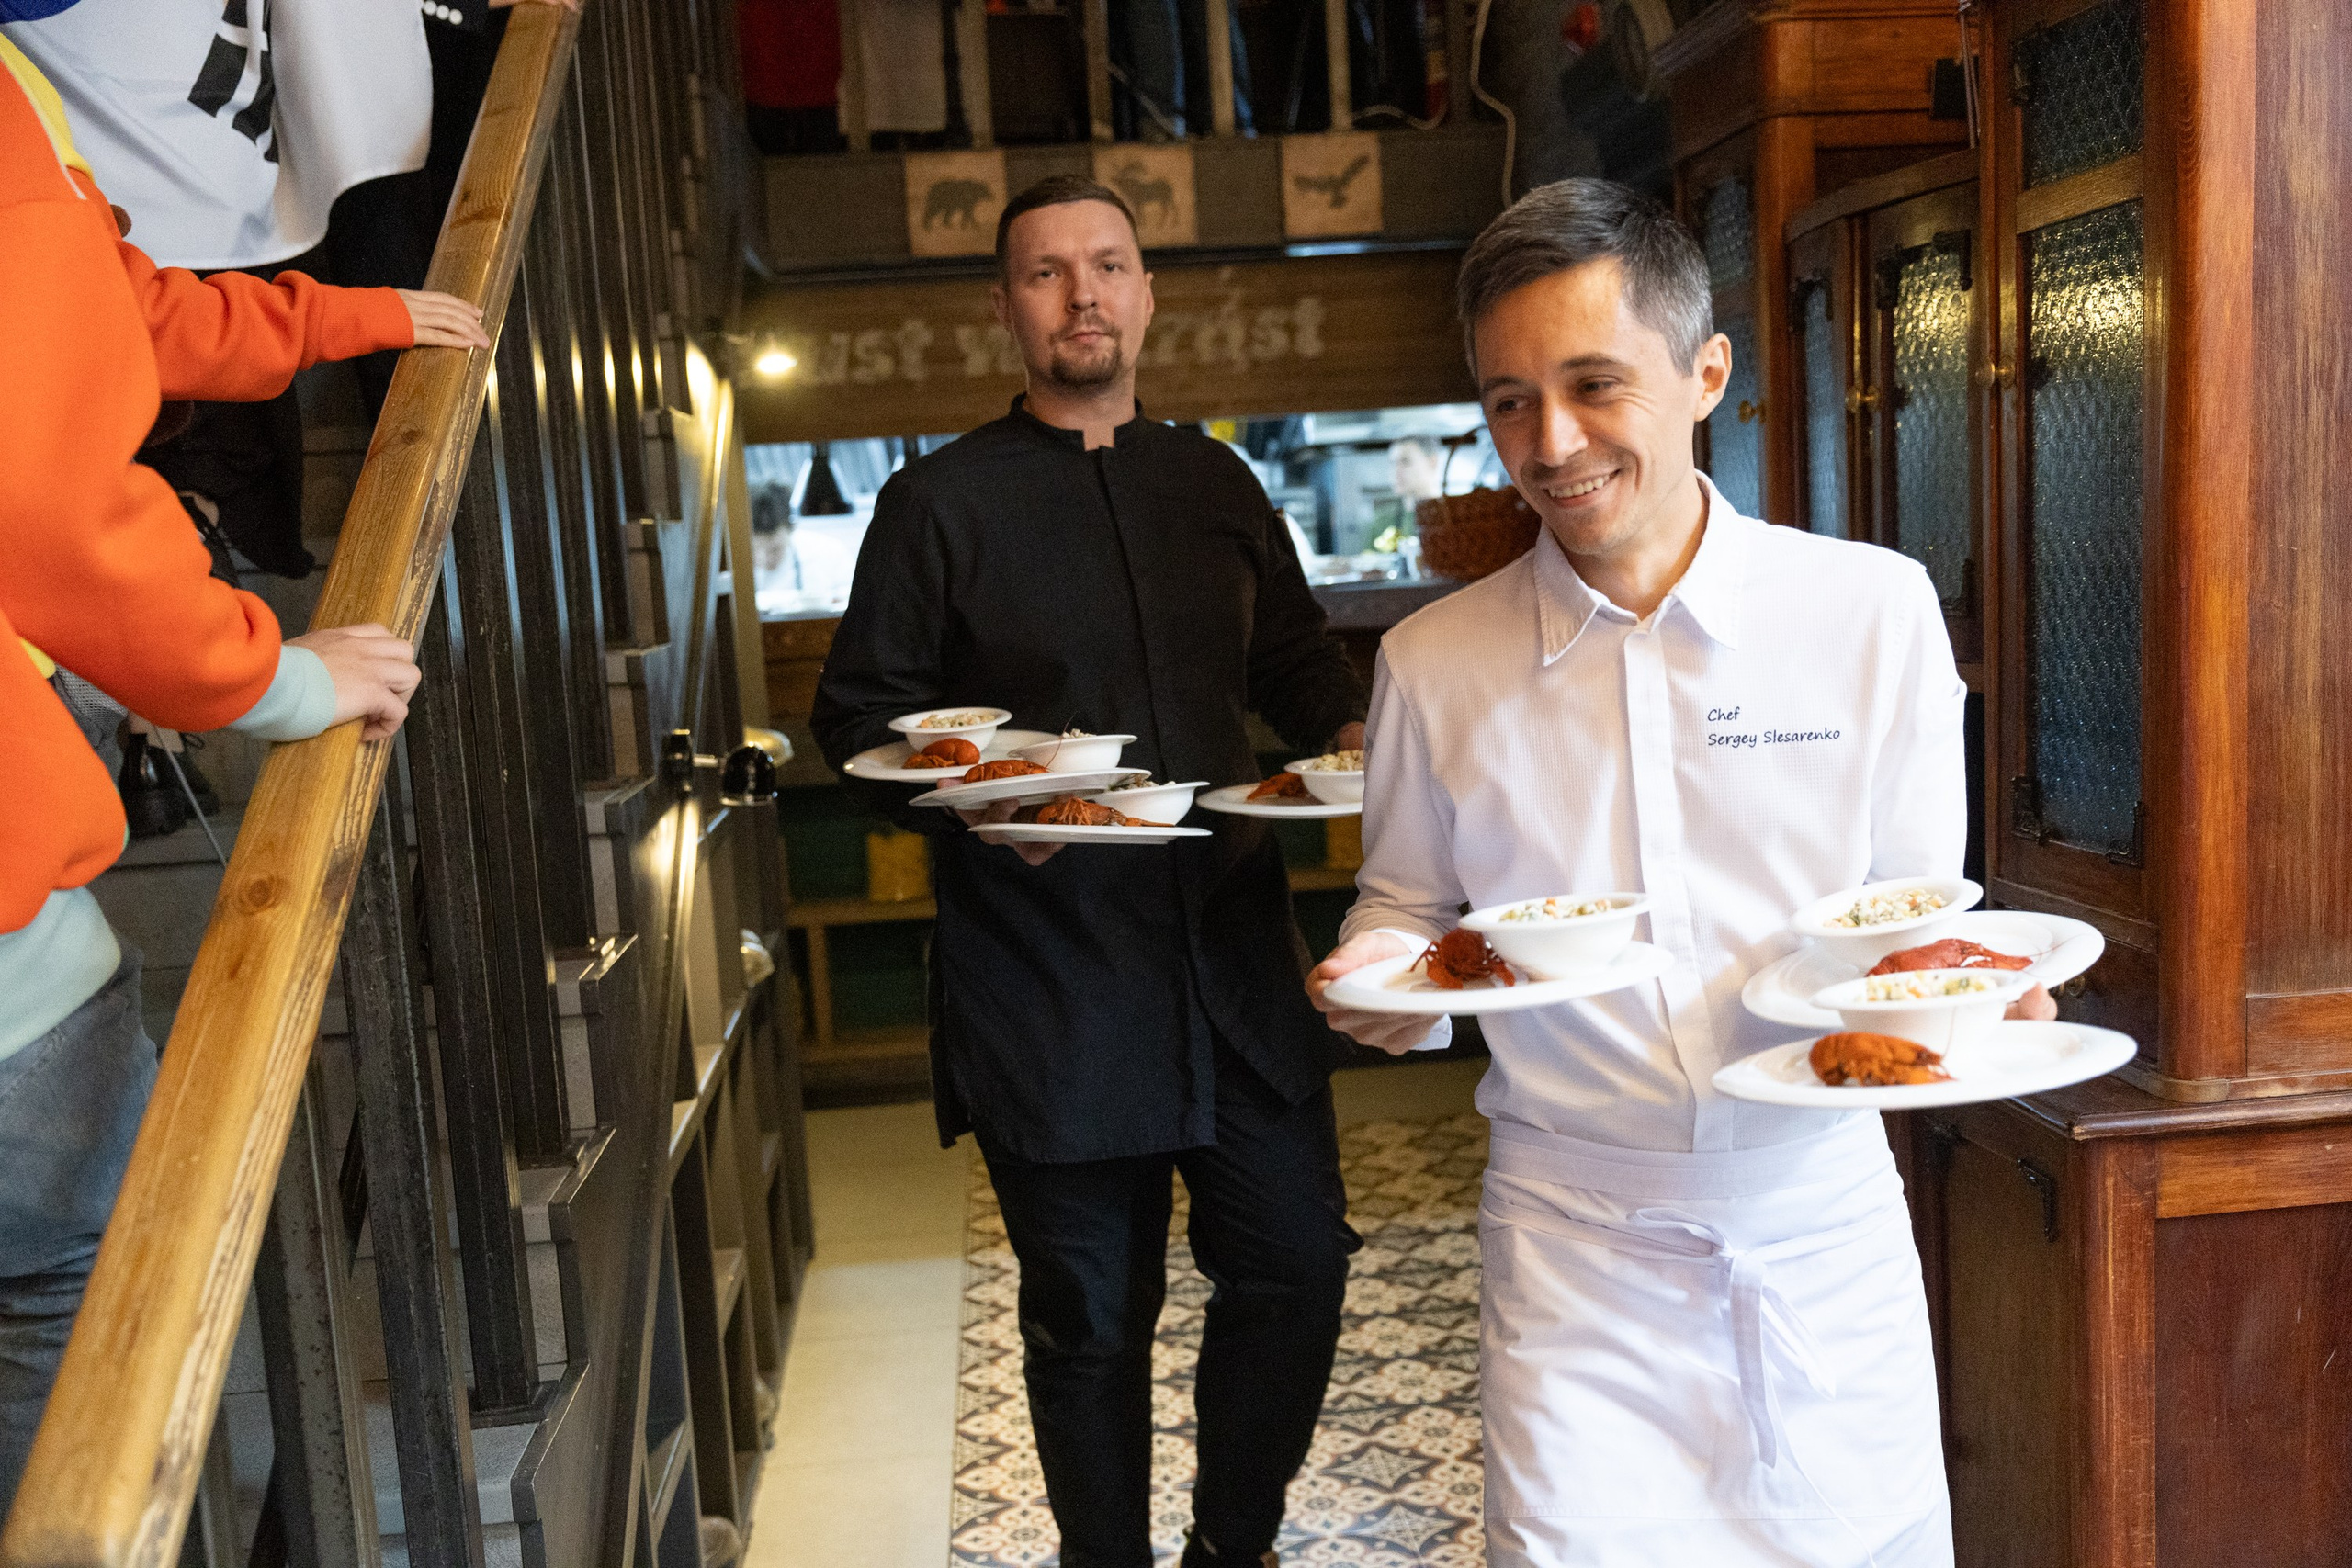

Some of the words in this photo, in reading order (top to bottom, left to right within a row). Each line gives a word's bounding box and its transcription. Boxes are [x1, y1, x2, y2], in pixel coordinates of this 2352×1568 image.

[1707, 705, 1741, 722] Chef
[1707, 732, 1758, 749] Sergey
[1763, 727, 1841, 744] Slesarenko
